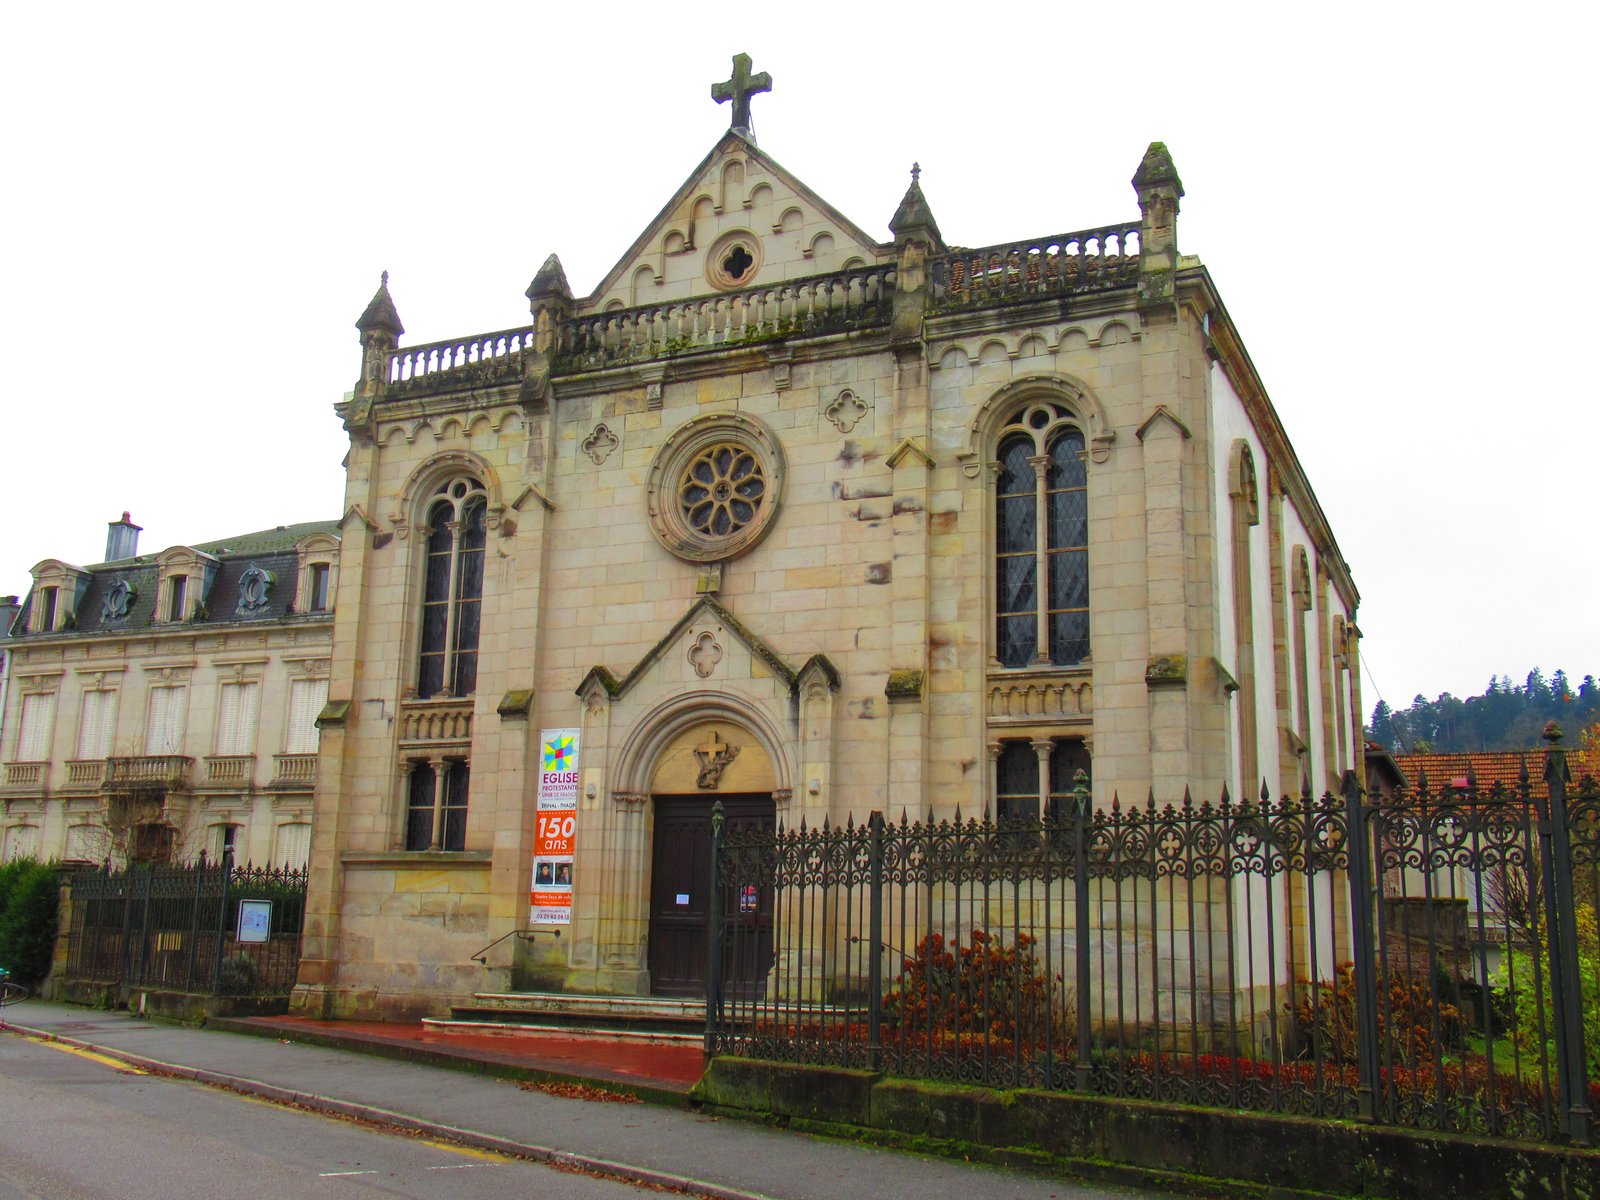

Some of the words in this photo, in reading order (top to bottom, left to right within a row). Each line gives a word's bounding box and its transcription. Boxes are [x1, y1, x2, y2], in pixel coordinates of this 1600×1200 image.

[543, 772, 578, 783] EGLISE
[539, 816, 576, 838] 150
[544, 840, 567, 850] ans
